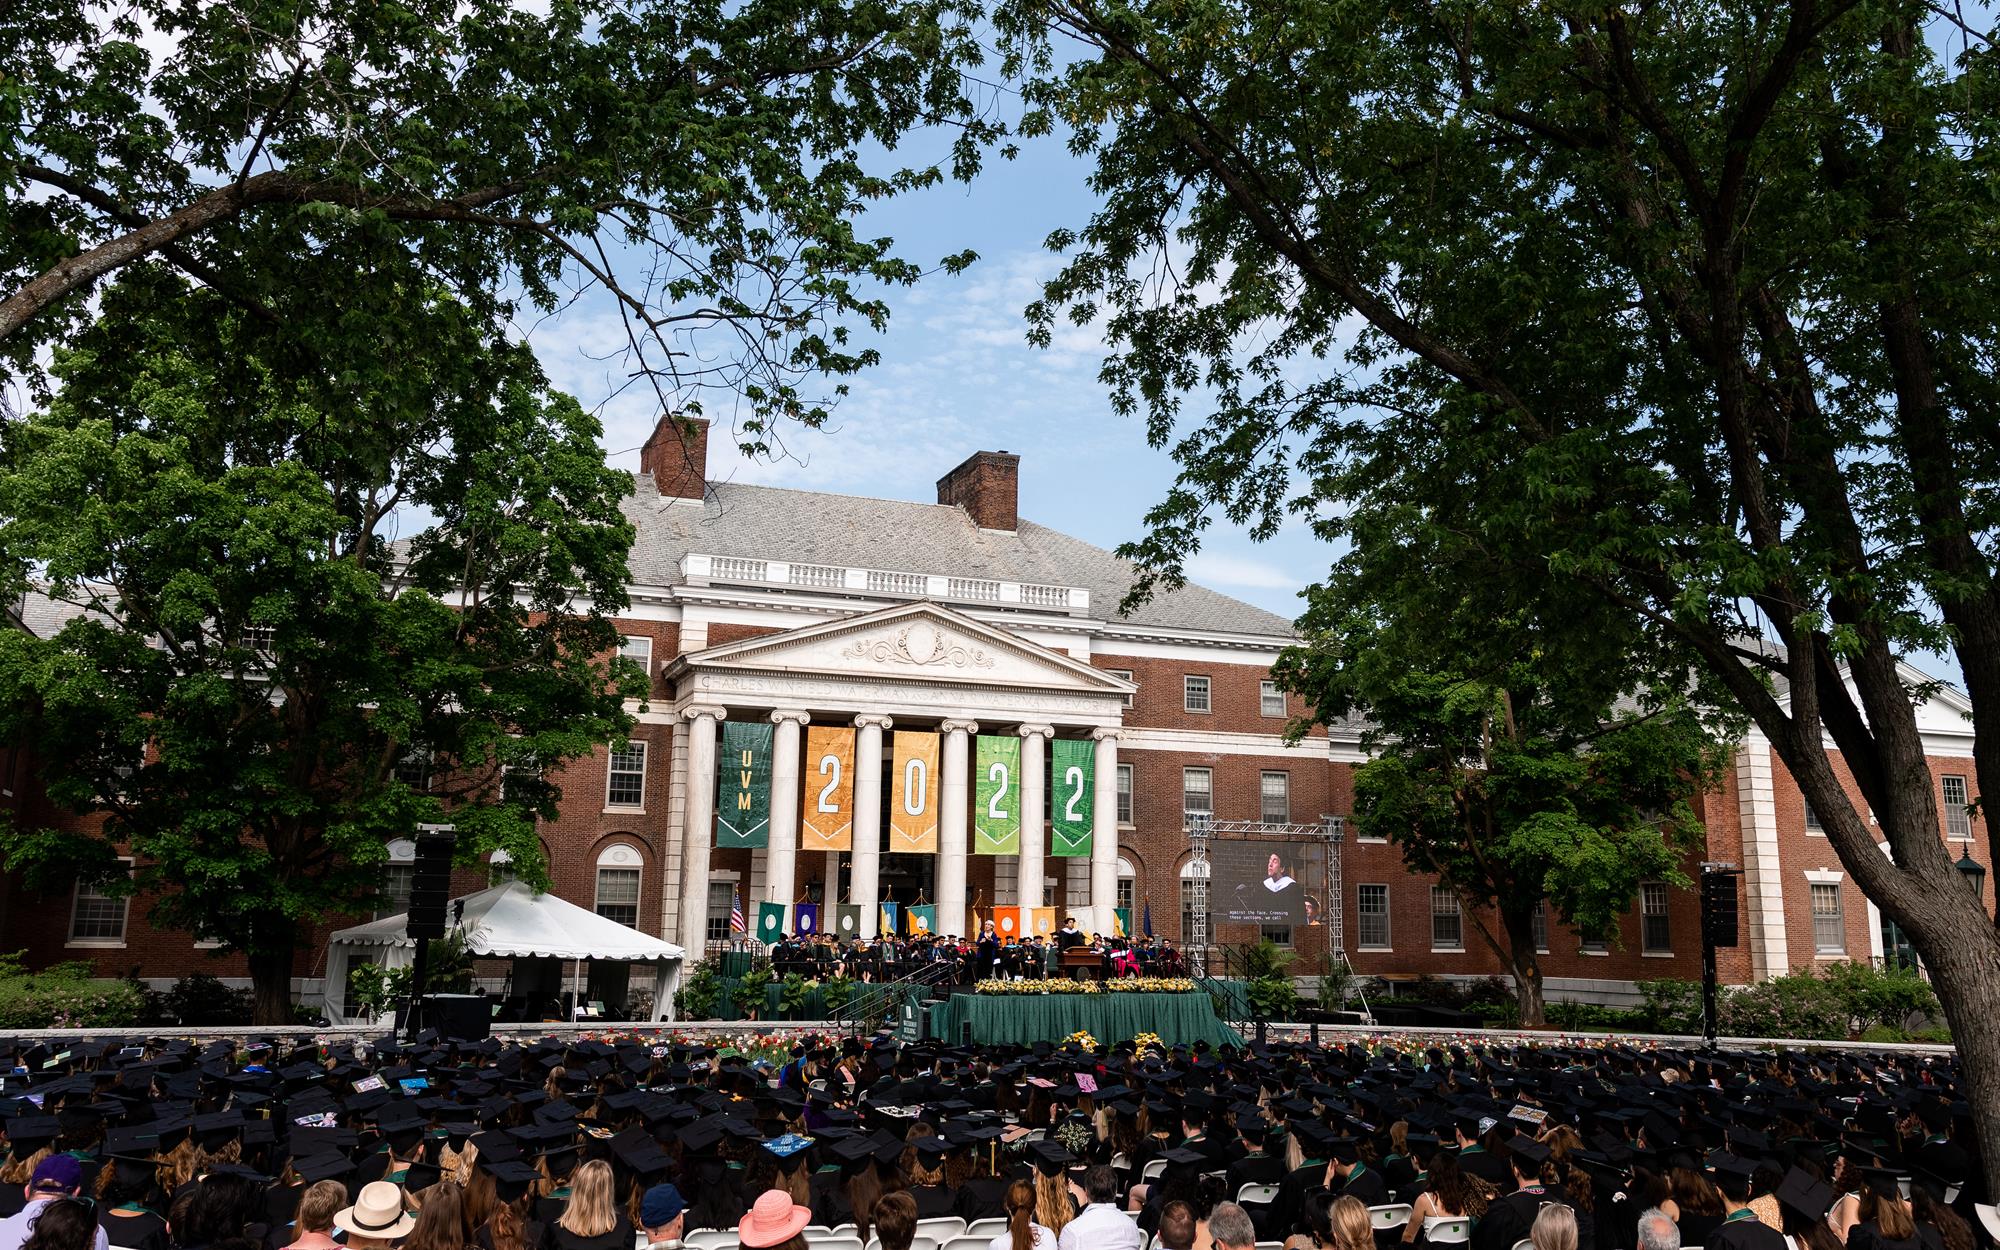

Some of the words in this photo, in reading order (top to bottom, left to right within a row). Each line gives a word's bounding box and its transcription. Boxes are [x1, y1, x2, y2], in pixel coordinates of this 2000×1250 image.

[702, 675, 763, 690] CHARLES
[768, 679, 832, 696] WINFIELD
[837, 683, 909, 700] WATERMAN
[982, 694, 1048, 709] WATERMAN
[738, 750, 752, 810] UVM
[818, 754, 841, 813] 2
[904, 758, 927, 816] 0
[988, 762, 1009, 819] 2
[1065, 766, 1084, 822] 2
